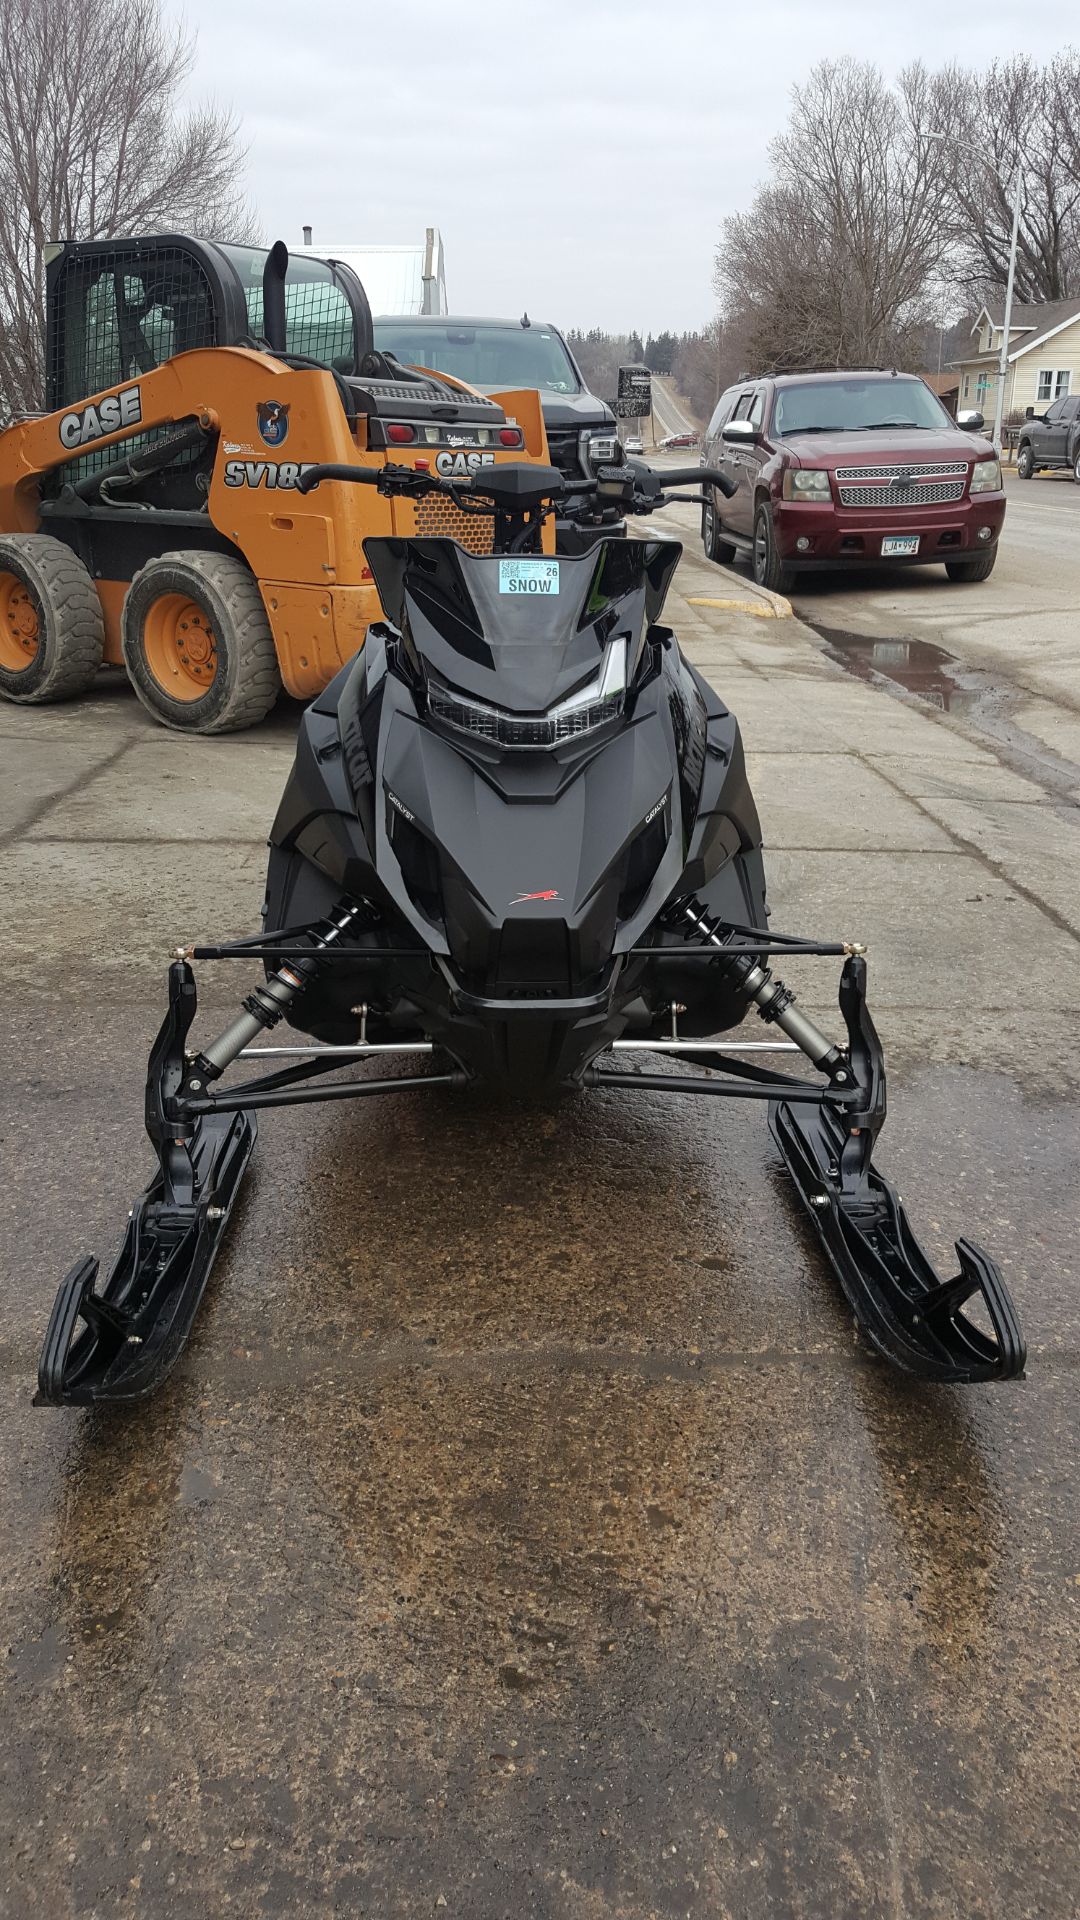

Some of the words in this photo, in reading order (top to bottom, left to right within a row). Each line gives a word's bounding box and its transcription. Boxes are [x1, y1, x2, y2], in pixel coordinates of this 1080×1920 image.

[59, 385, 141, 448] CASE
[903, 540, 917, 550] 994
[546, 567, 558, 577] 26
[508, 578, 552, 592] SNOW
[388, 792, 415, 822] CATALYST
[645, 794, 668, 824] CATALYST
